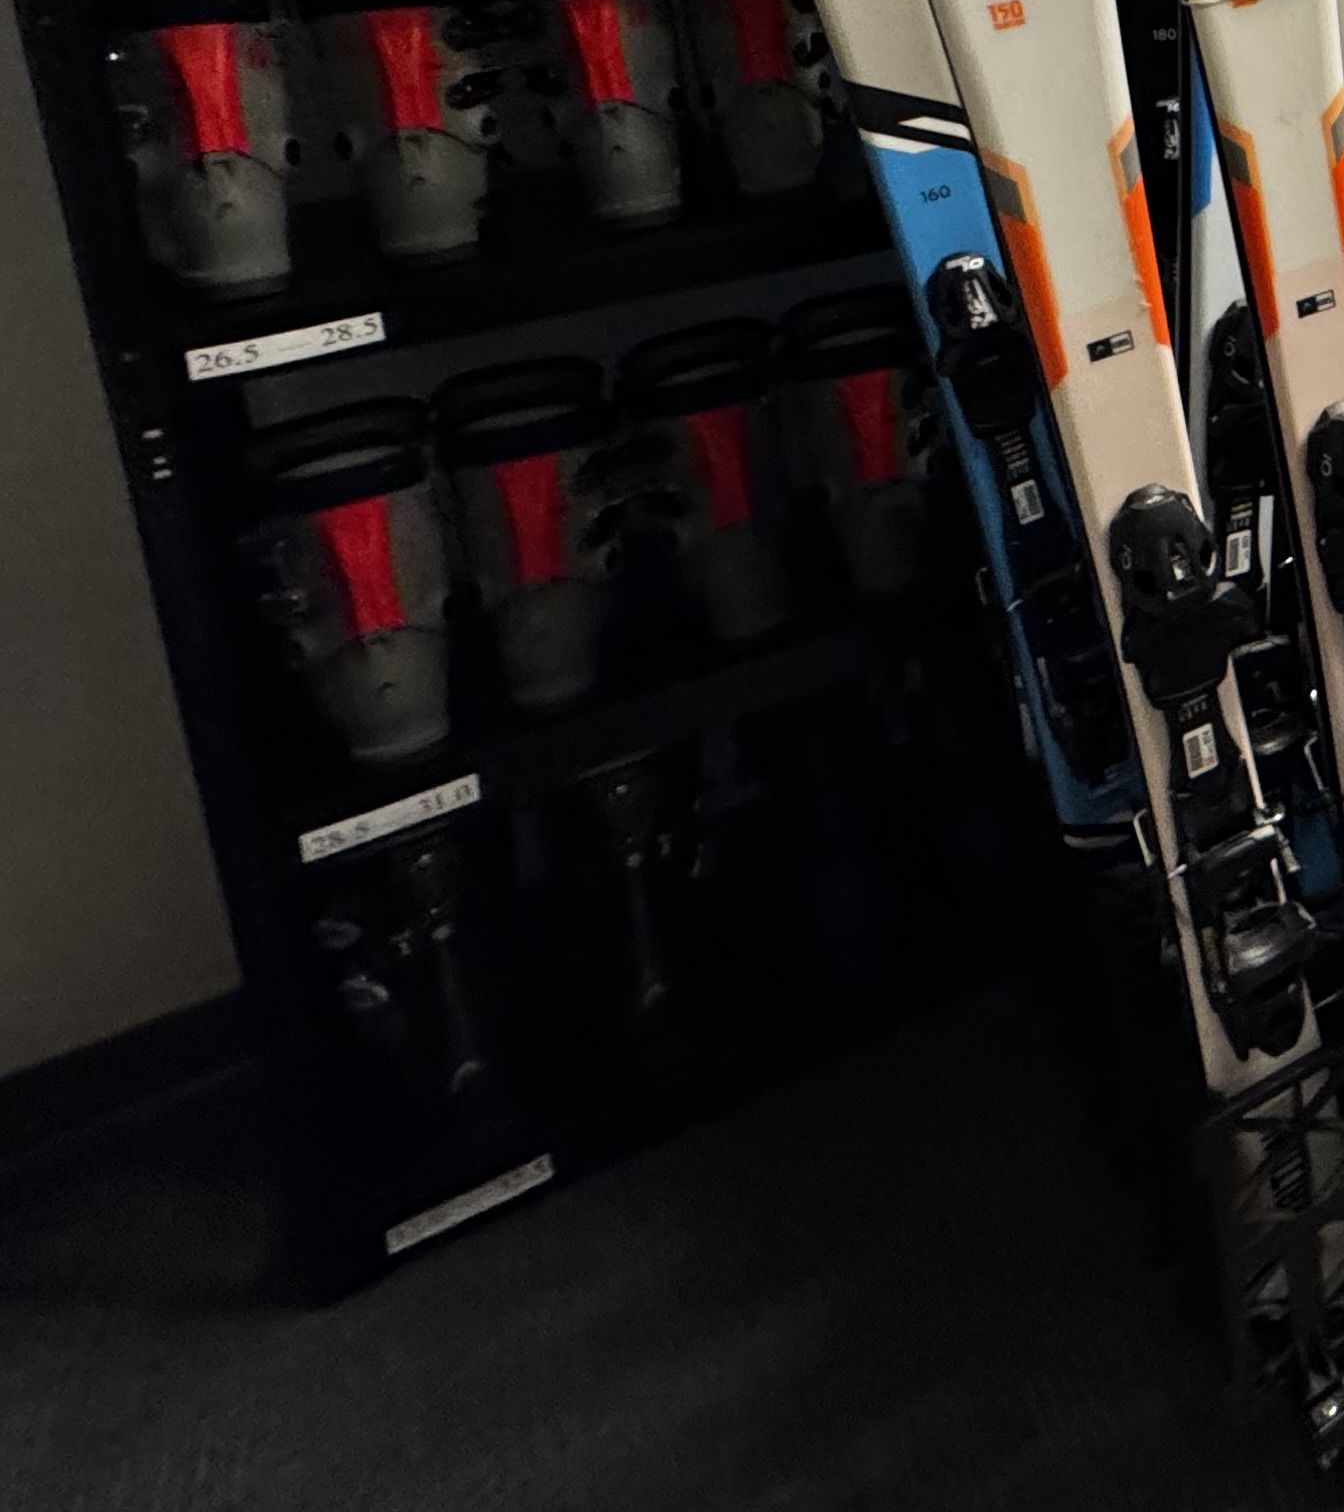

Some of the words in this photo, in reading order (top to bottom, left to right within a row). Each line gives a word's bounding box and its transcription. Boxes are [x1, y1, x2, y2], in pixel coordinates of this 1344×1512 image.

[986, 0, 1026, 28] 150
[1152, 27, 1178, 41] 180
[919, 183, 952, 204] 160
[194, 343, 261, 374] 26.5
[319, 317, 379, 347] 28.5
